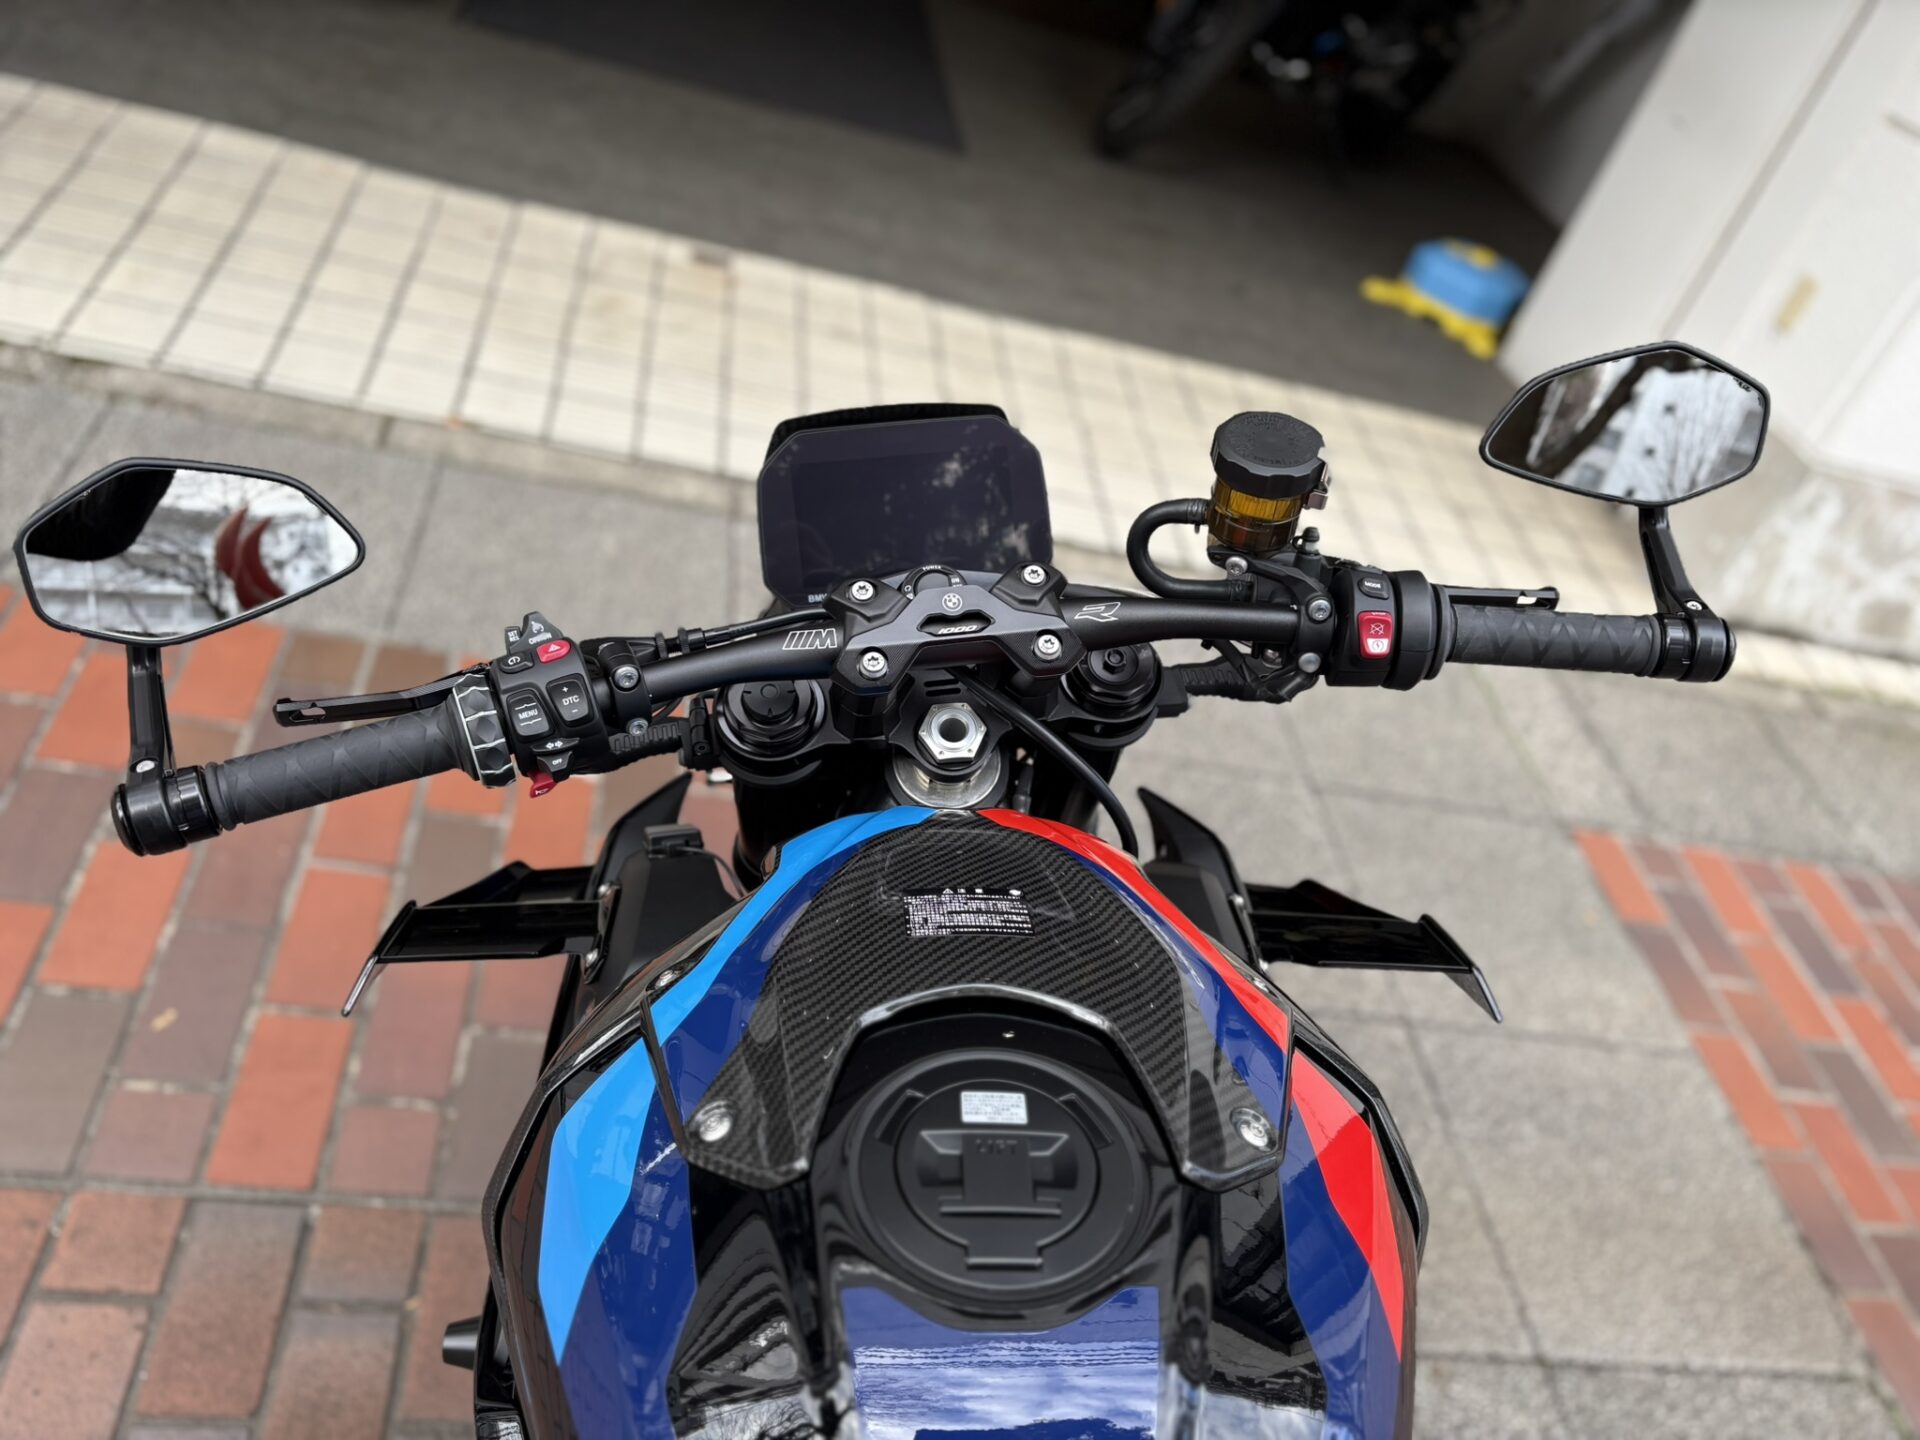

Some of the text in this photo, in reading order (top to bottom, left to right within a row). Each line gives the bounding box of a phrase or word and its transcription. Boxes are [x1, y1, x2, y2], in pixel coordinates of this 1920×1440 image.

[938, 625, 978, 635] 1000
[562, 695, 580, 706] DTC
[518, 708, 538, 720] MENU
